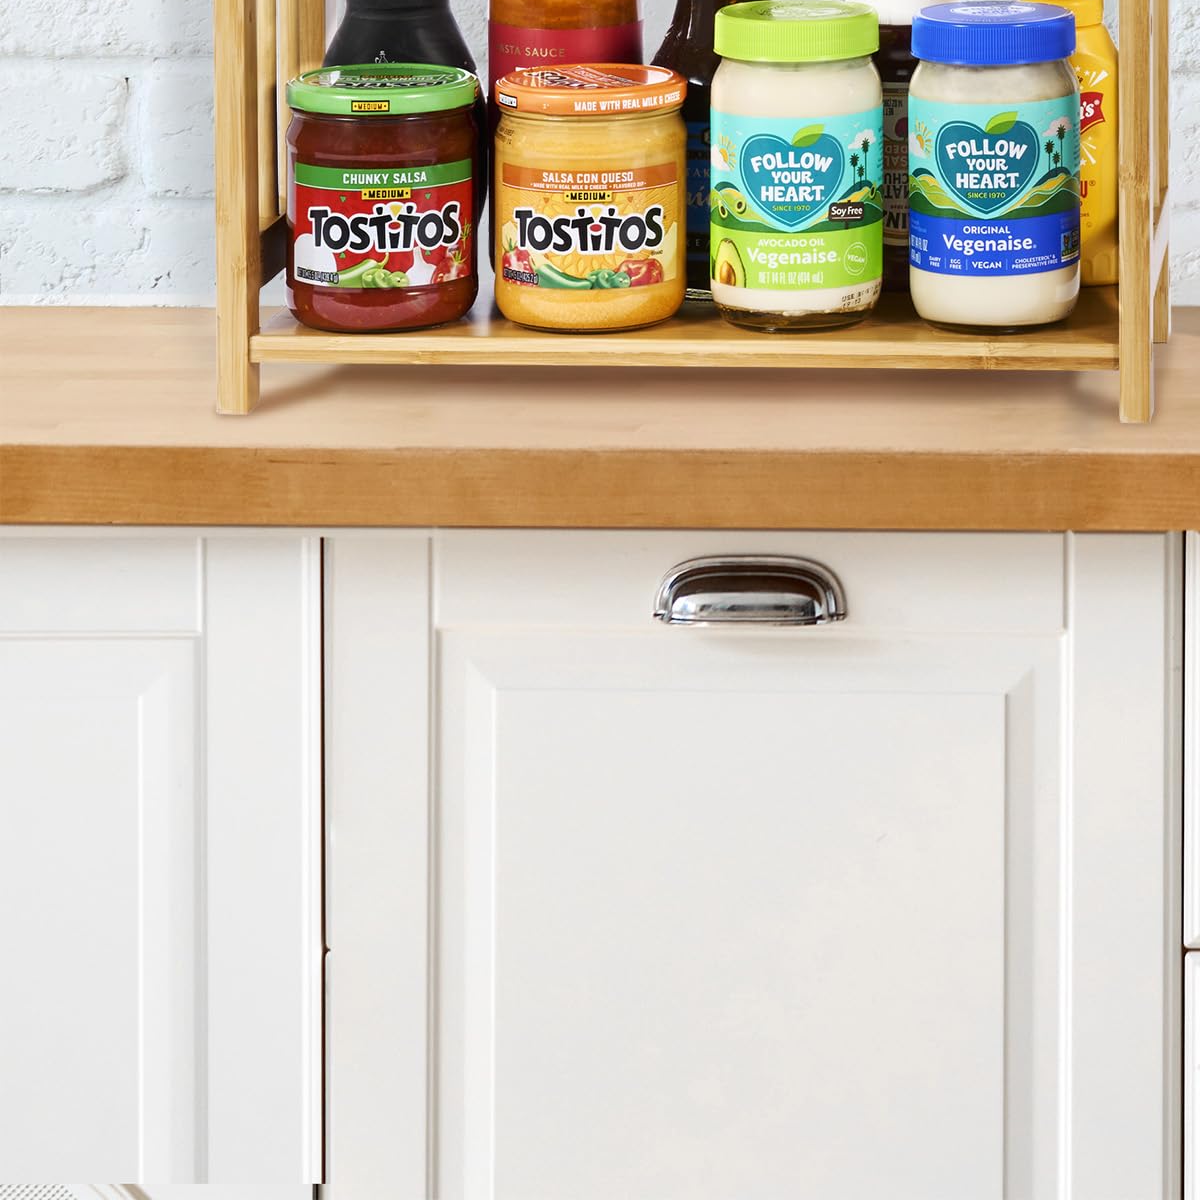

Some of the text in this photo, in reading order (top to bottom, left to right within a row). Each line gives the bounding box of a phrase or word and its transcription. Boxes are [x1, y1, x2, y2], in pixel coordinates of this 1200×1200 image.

[524, 47, 566, 58] SAUCE
[574, 100, 597, 112] MADE
[599, 99, 621, 111] WITH
[622, 98, 640, 109] REAL
[642, 96, 658, 108] MILK
[945, 138, 1028, 160] FOLLOW
[750, 151, 834, 173] FOLLOW
[966, 158, 1009, 171] YOUR
[342, 171, 428, 185] CHUNKY SALSA
[542, 171, 634, 185] SALSA CON QUESO
[771, 170, 814, 184] YOUR
[368, 189, 404, 199] MEDIUM
[570, 192, 606, 201] MEDIUM
[830, 205, 863, 218] Soy Free
[962, 225, 1011, 235] ORIGINAL
[758, 238, 825, 248] AVOCADO OIL
[942, 233, 1033, 257] Vegenaise
[746, 246, 838, 269] Vegenaise
[847, 254, 865, 264] VEGAN
[1011, 258, 1058, 270] PRESERVATIVE FREE
[971, 261, 1002, 270] VEGAN
